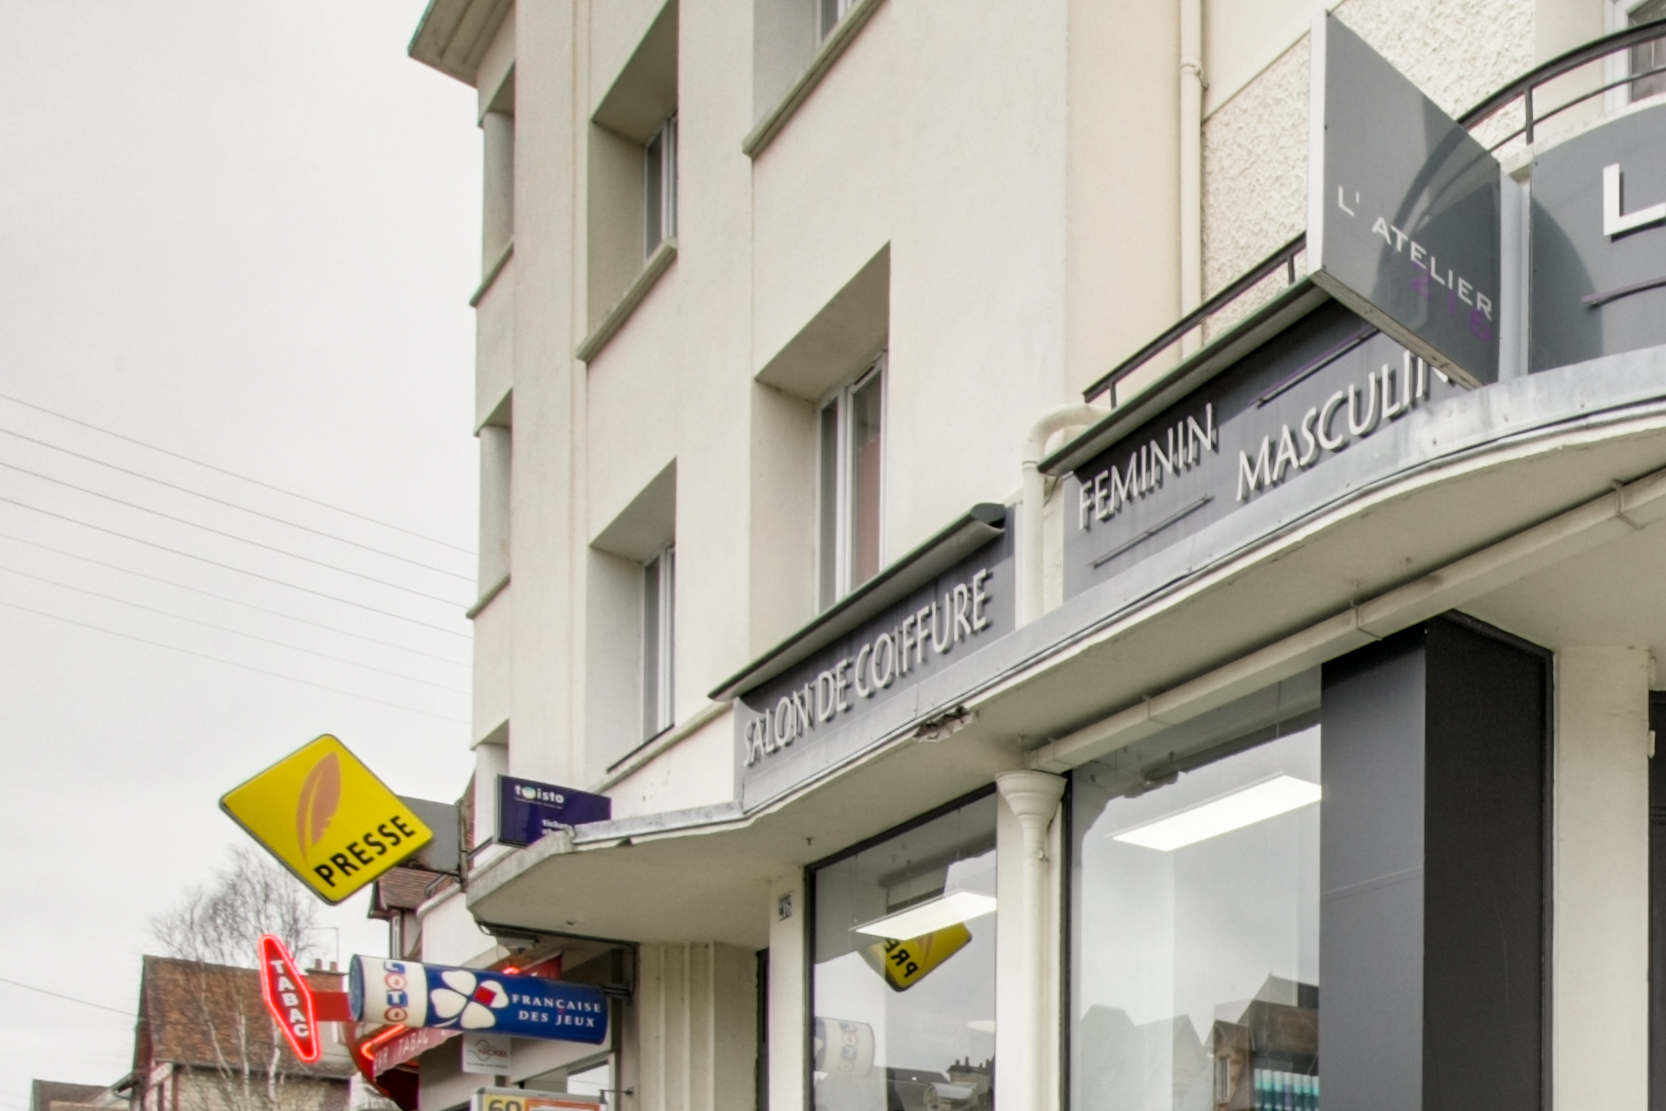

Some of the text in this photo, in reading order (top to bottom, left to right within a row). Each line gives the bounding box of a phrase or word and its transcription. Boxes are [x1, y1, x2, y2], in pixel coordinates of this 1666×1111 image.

[1338, 185, 1492, 321] L' ATELIER
[1079, 403, 1215, 530] FEMININ
[744, 568, 987, 767] SALON DE COIFFURE
[313, 815, 416, 888] PRESSE
[270, 959, 310, 1038] TABAC
[511, 993, 601, 1013] FRANÇAISE
[518, 1010, 595, 1028] DES JEUX
